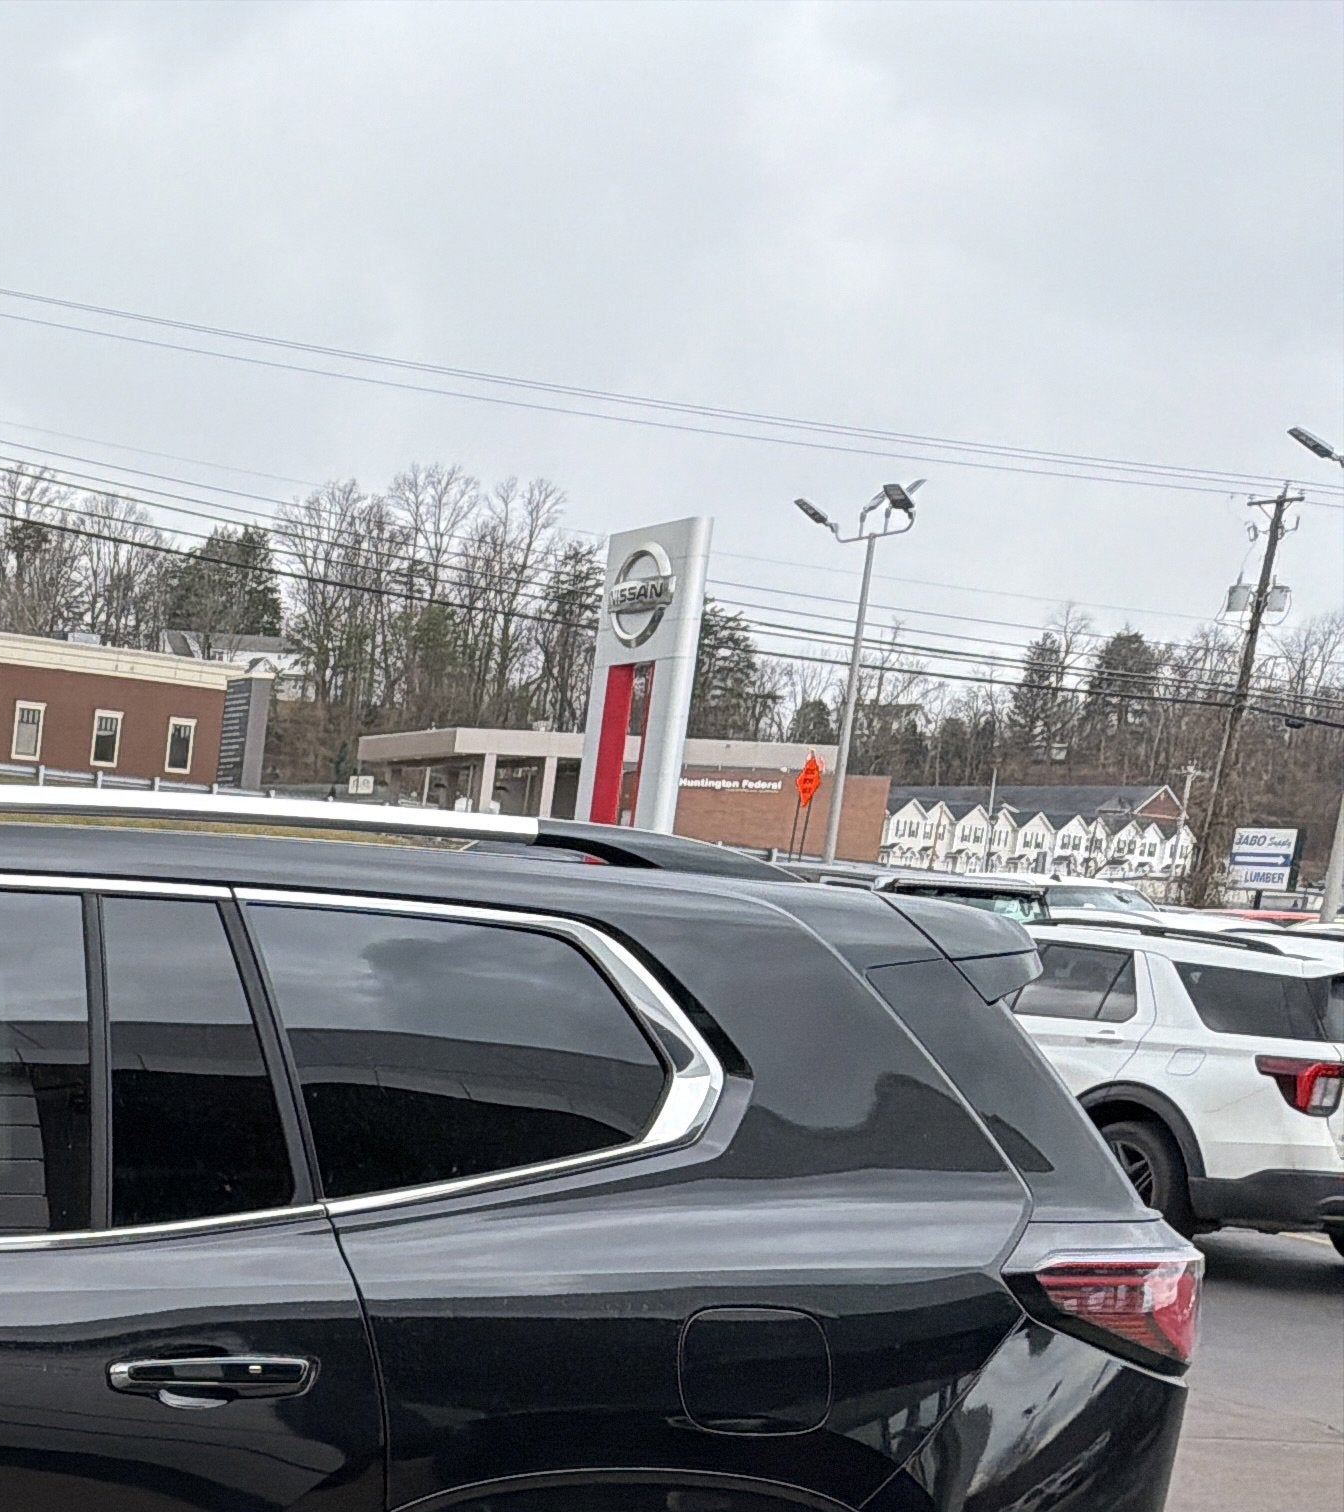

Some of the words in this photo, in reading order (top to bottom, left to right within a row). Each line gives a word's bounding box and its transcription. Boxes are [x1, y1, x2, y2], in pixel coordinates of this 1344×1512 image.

[609, 581, 664, 607] NISSAN
[678, 777, 740, 790] Huntington
[741, 779, 783, 791] Federal
[1234, 832, 1267, 847] JABO
[1243, 870, 1285, 884] LUMBER
